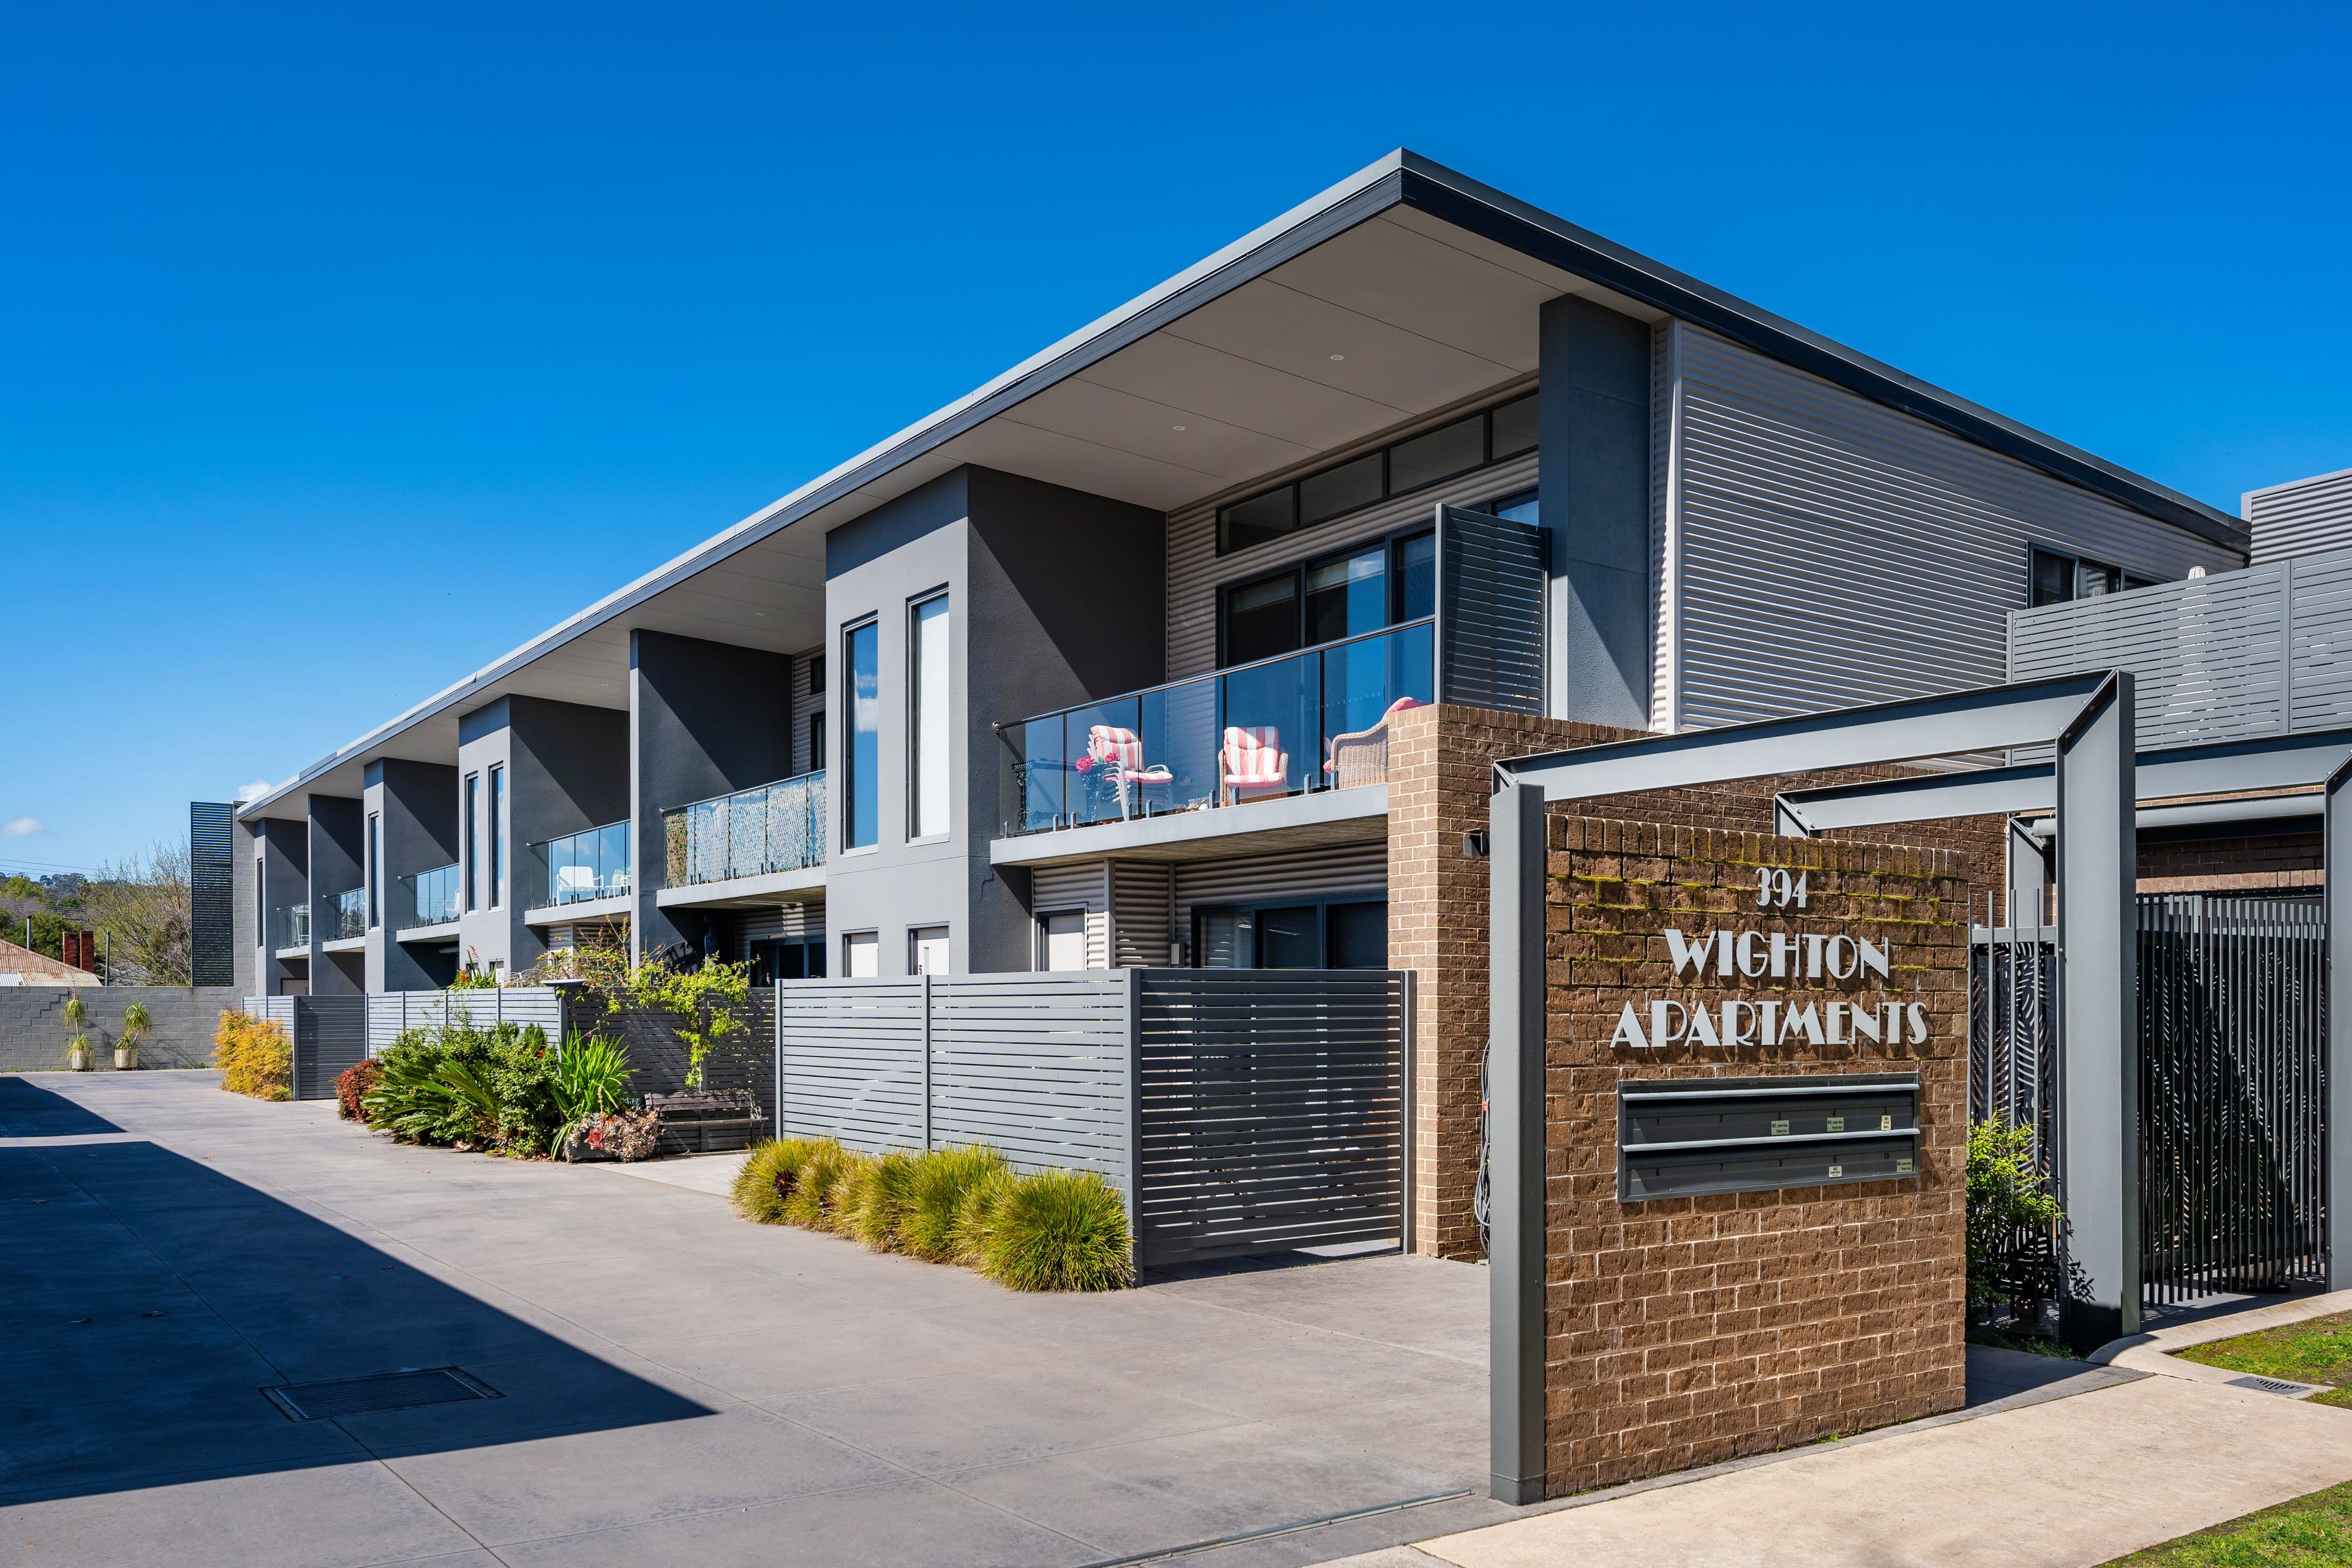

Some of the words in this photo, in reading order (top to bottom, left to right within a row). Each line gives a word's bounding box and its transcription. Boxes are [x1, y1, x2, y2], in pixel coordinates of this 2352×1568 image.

[1755, 867, 1807, 908] 394
[1664, 929, 1889, 979] WIGHTON
[1610, 1000, 1927, 1049] APARTMENTS
[1656, 1117, 1660, 1126] 1
[1719, 1114, 1724, 1123] 2
[1779, 1158, 1783, 1167] 8
